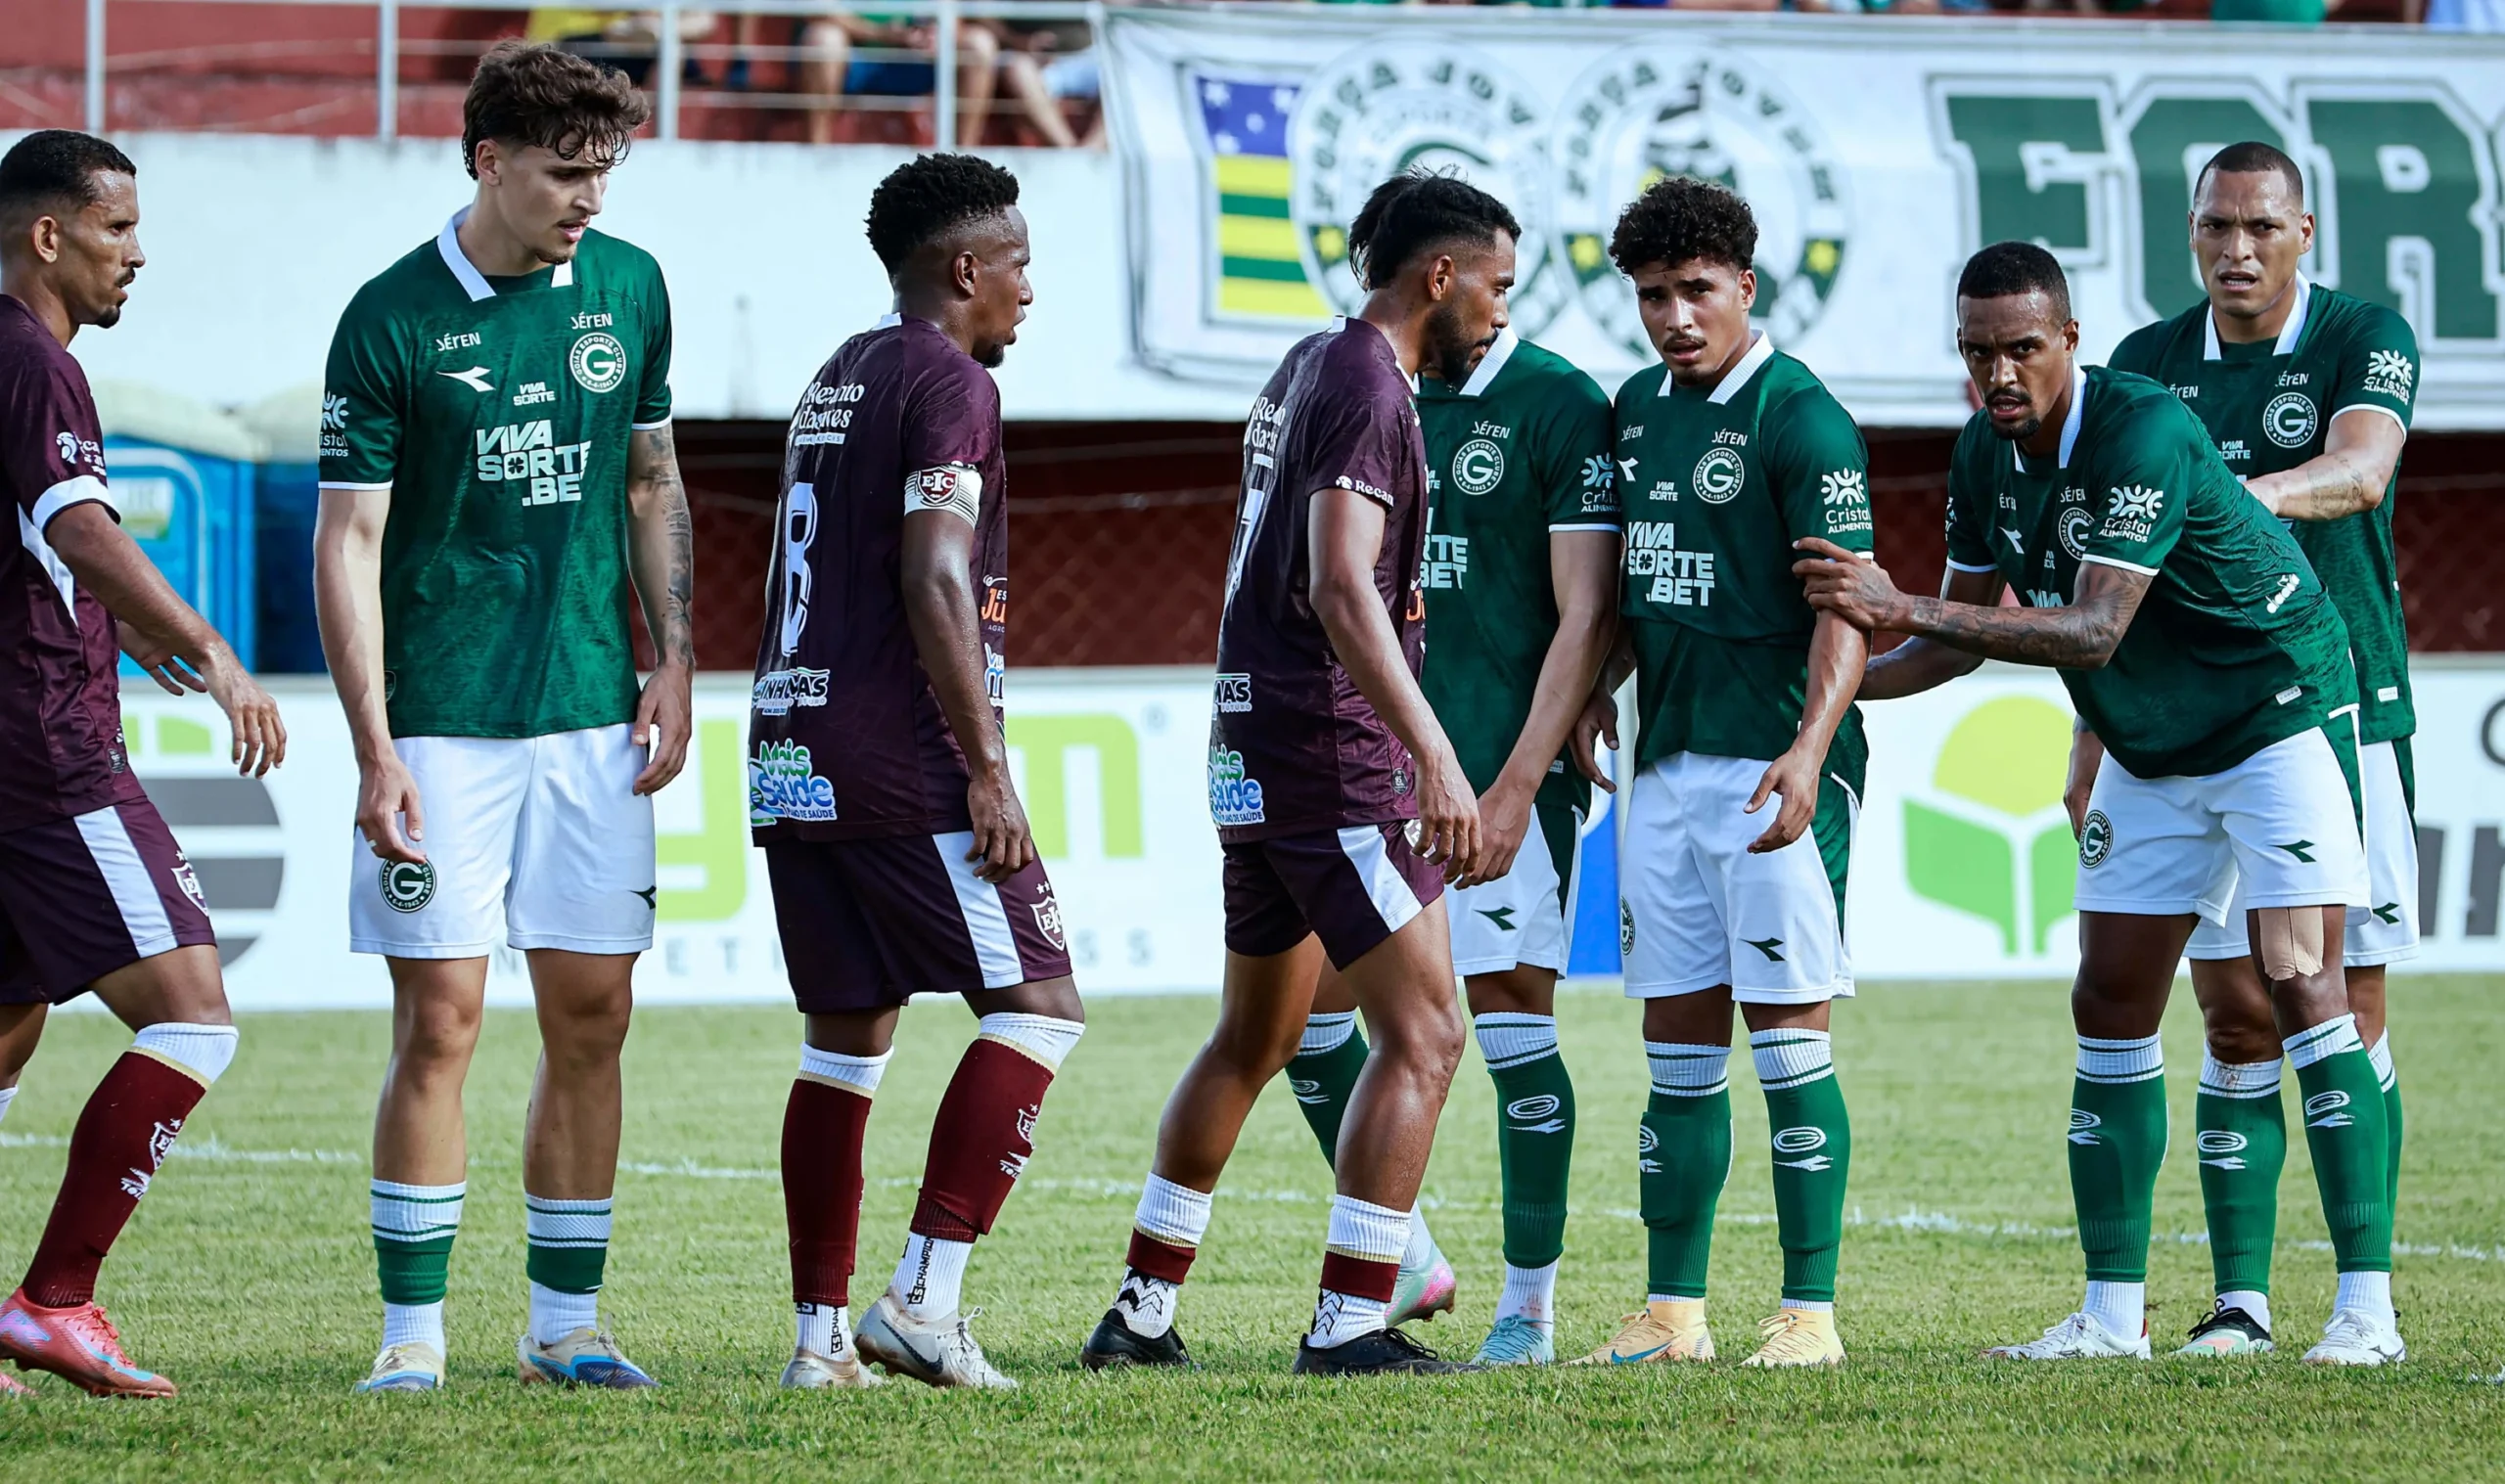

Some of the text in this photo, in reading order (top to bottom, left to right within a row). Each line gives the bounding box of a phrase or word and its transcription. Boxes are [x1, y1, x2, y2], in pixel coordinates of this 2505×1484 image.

[1930, 76, 2505, 354] FOR
[580, 343, 616, 382] G
[513, 390, 556, 406] SORTE
[519, 382, 547, 395] VIVA
[2273, 402, 2307, 438] G
[477, 420, 553, 455] VIVA
[2222, 440, 2244, 450] VIVA
[478, 440, 592, 481] SORTE
[1462, 450, 1494, 484] G
[1703, 457, 1735, 493] G
[522, 472, 585, 507] .BE
[1649, 491, 1678, 502] SORTE
[1656, 481, 1675, 491] VIVA
[1628, 521, 1674, 550] VIVA
[1628, 549, 1714, 578] SORTE
[808, 808, 835, 819] SAÚDE
[389, 862, 426, 900] G
